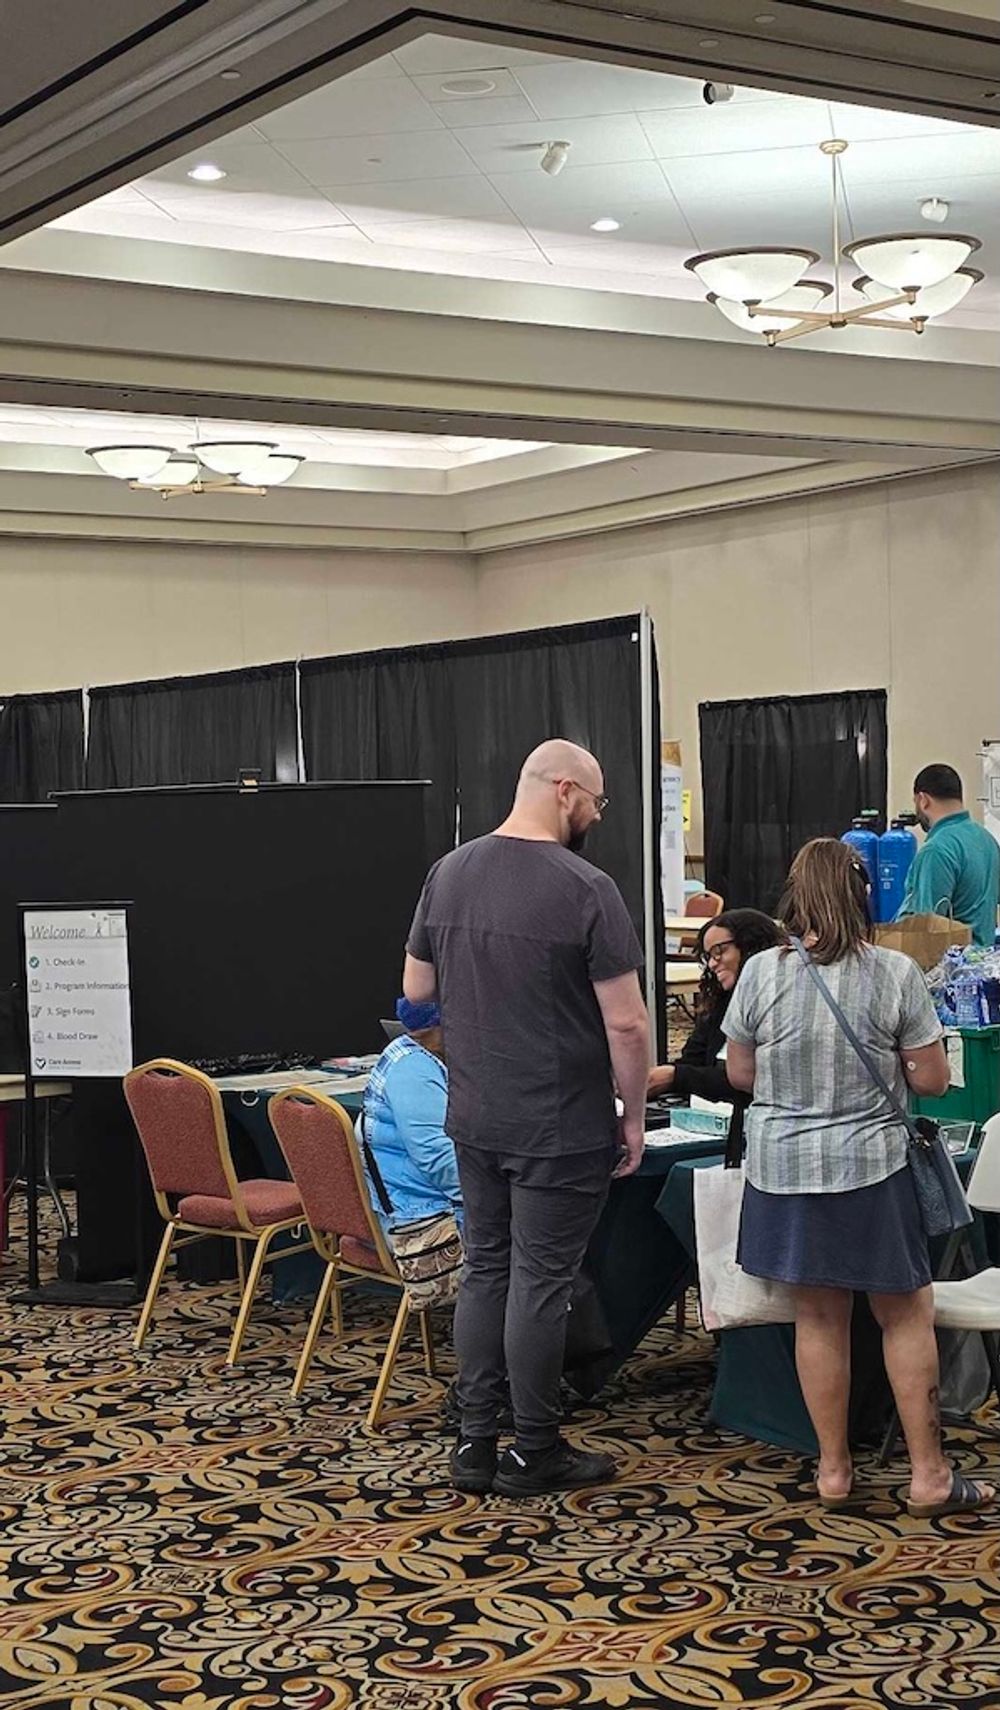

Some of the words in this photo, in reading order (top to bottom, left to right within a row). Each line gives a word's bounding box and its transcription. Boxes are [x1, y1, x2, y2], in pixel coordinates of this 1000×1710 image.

[30, 924, 86, 940] Welcome
[53, 956, 86, 967] Check-In
[45, 982, 52, 991] 2.
[54, 982, 85, 992] Program
[46, 1006, 53, 1016] 3.
[55, 1006, 71, 1017] Sign
[73, 1006, 95, 1016] Forms
[47, 1032, 54, 1041] 4.
[56, 1031, 78, 1041] Blood
[79, 1032, 98, 1041] Draw
[48, 1058, 61, 1066] Care
